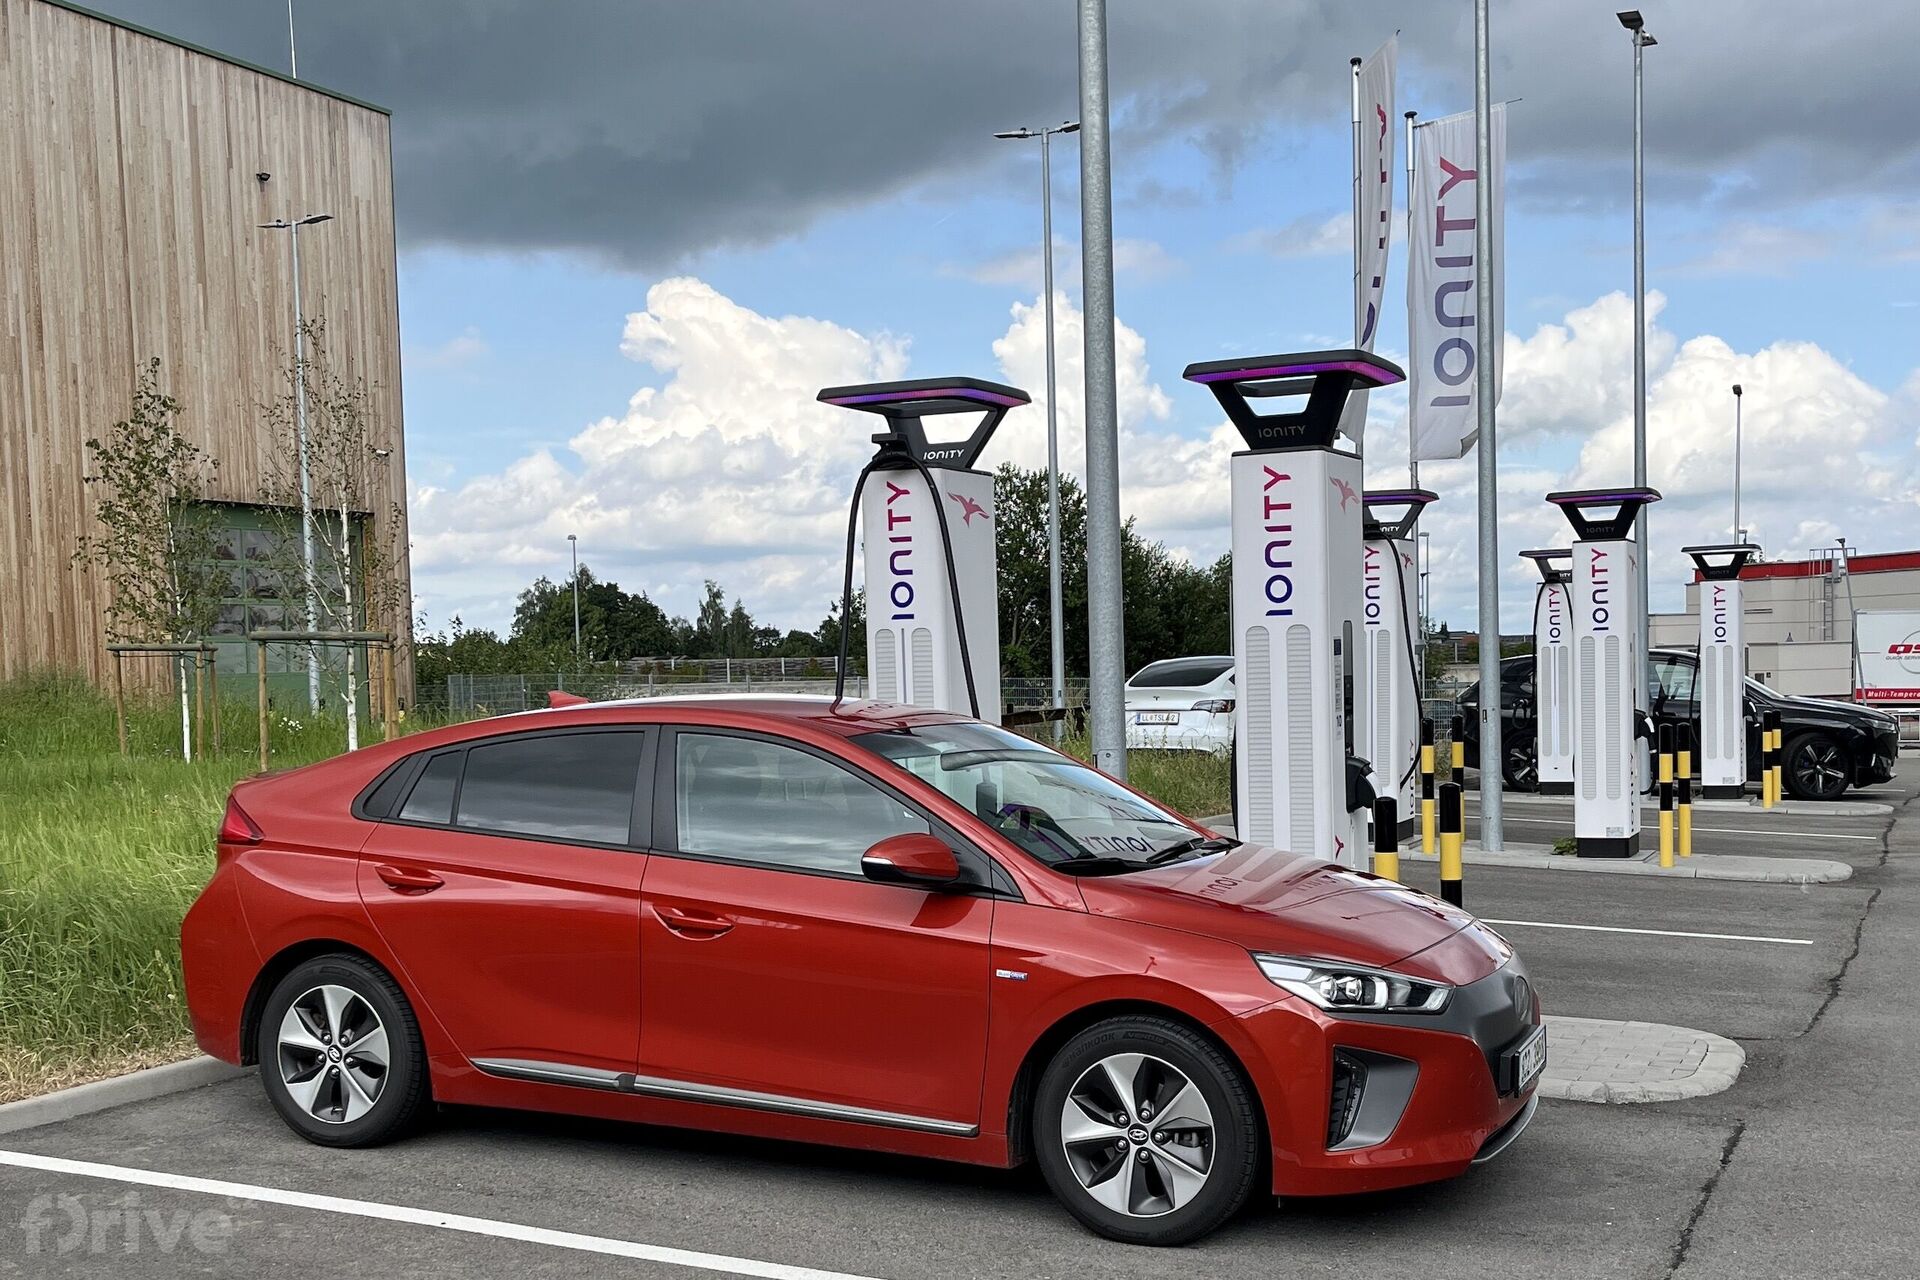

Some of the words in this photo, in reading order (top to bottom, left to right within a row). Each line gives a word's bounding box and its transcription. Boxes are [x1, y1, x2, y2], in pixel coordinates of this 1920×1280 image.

[1430, 156, 1479, 407] IONITY
[923, 448, 965, 460] IONITY
[1258, 424, 1307, 438] IONITY
[886, 481, 915, 621] IONITY
[1263, 465, 1293, 617] IONITY
[1364, 546, 1381, 625] IONITY
[1548, 588, 1561, 644] IONITY
[1591, 548, 1609, 631] IONITY
[1713, 585, 1727, 643] IONITY
